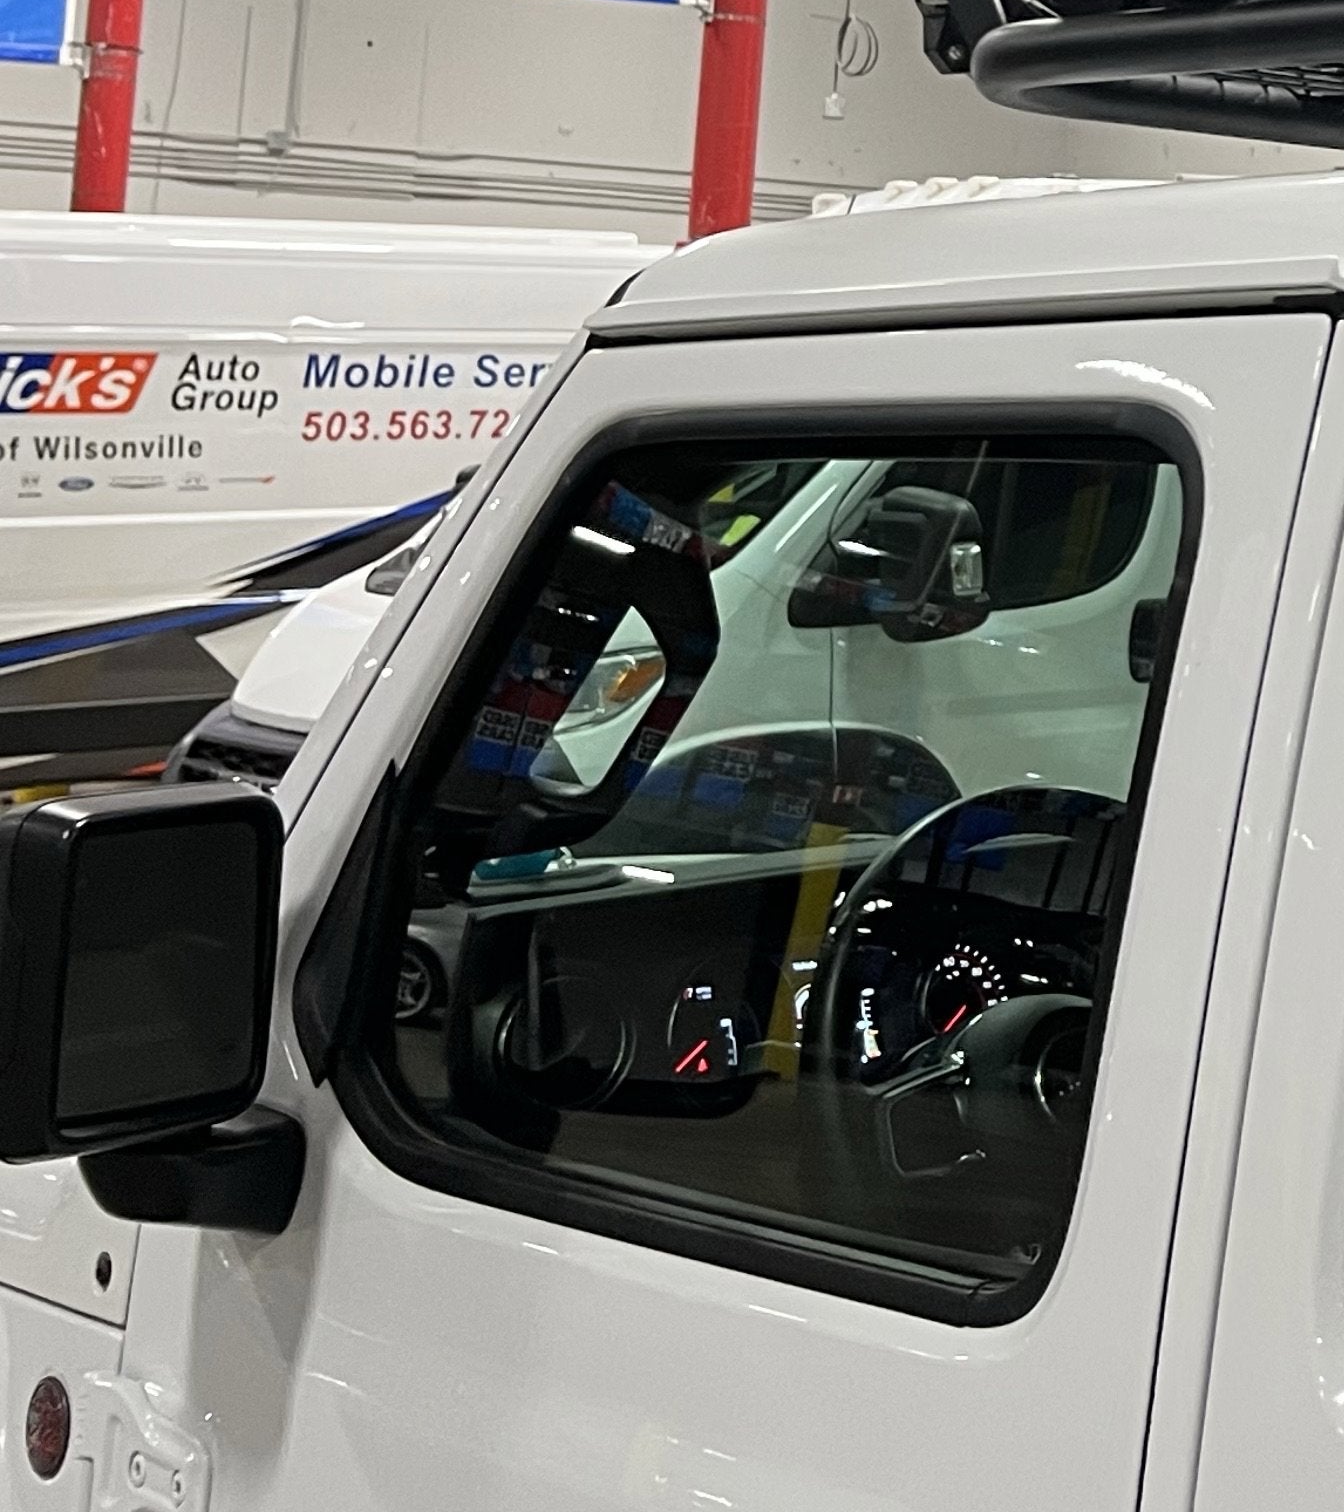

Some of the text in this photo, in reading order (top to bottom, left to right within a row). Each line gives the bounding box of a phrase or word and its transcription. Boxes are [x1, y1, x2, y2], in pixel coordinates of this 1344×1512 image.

[177, 353, 260, 381] Auto
[302, 354, 552, 388] Mobile Ser
[171, 382, 279, 418] Group
[301, 410, 511, 441] 503.563.72
[34, 435, 203, 460] Wilsonville
